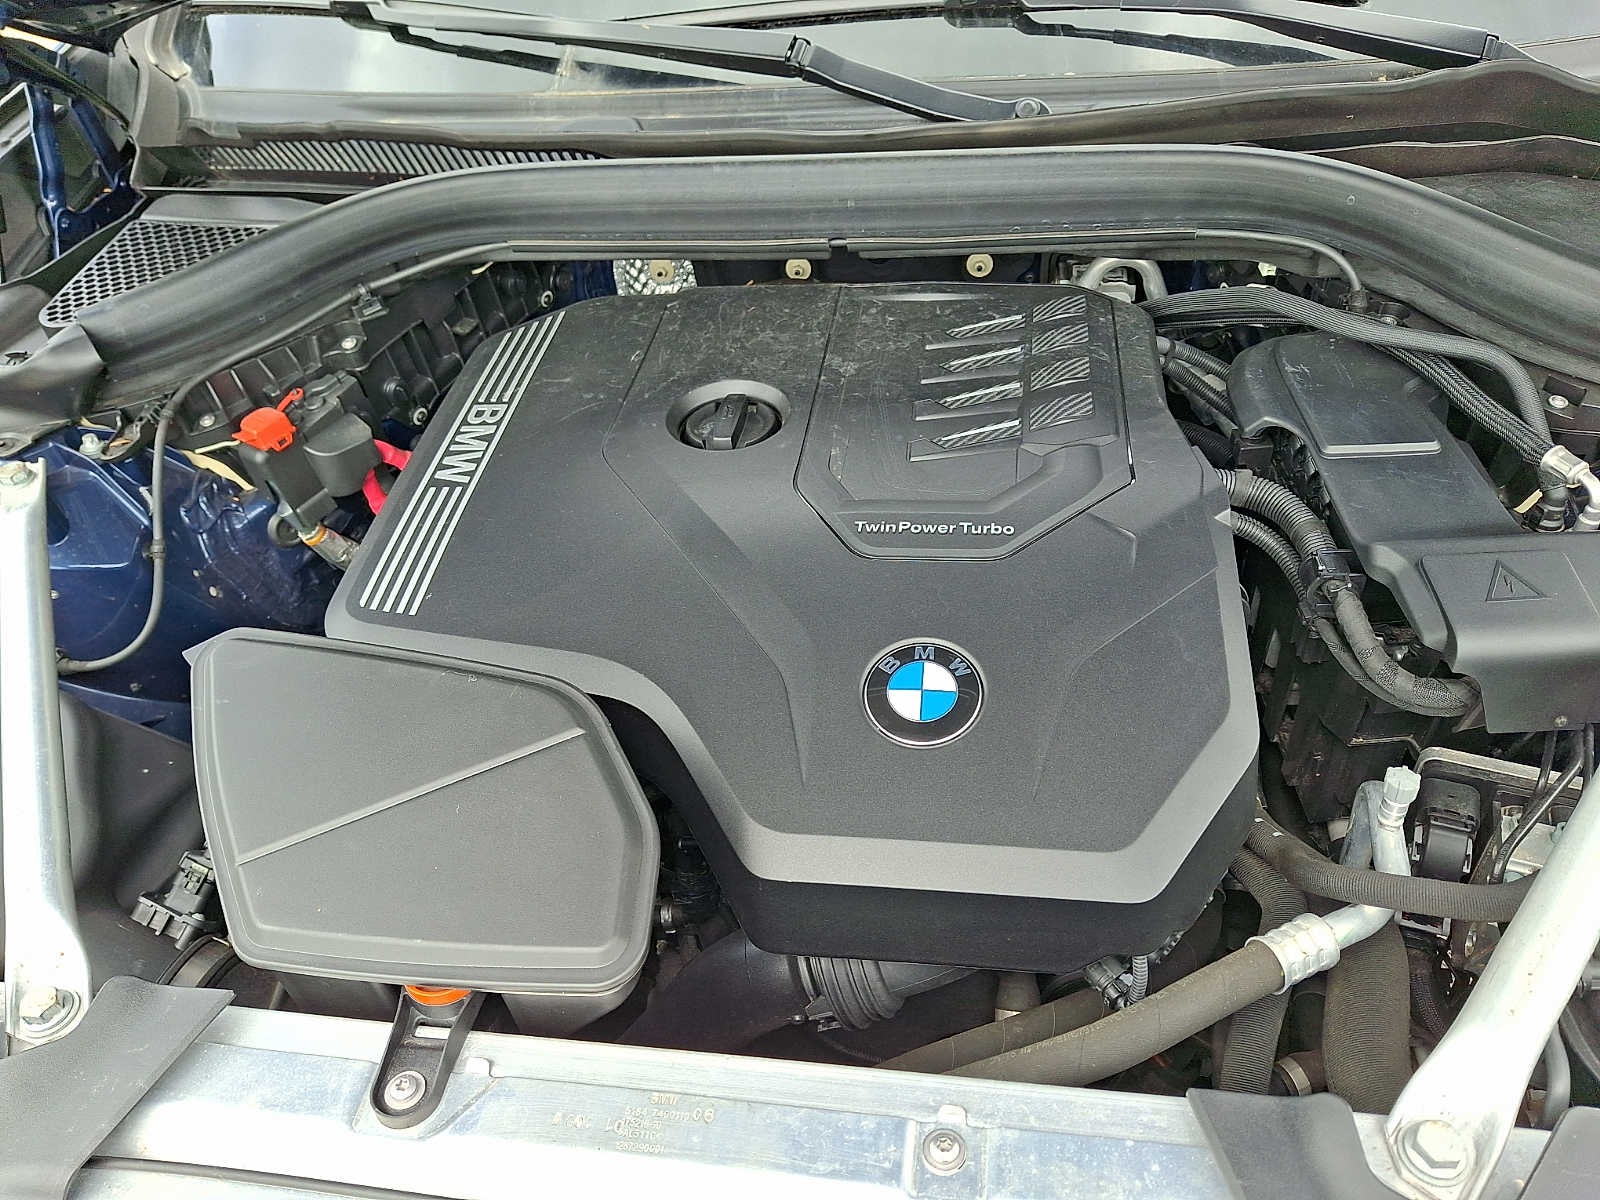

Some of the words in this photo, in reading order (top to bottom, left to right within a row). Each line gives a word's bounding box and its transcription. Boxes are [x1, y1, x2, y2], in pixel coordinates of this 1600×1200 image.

[433, 402, 505, 485] BMW
[854, 520, 957, 535] TwinPower
[959, 521, 1016, 536] Turbo
[878, 646, 972, 677] BMW
